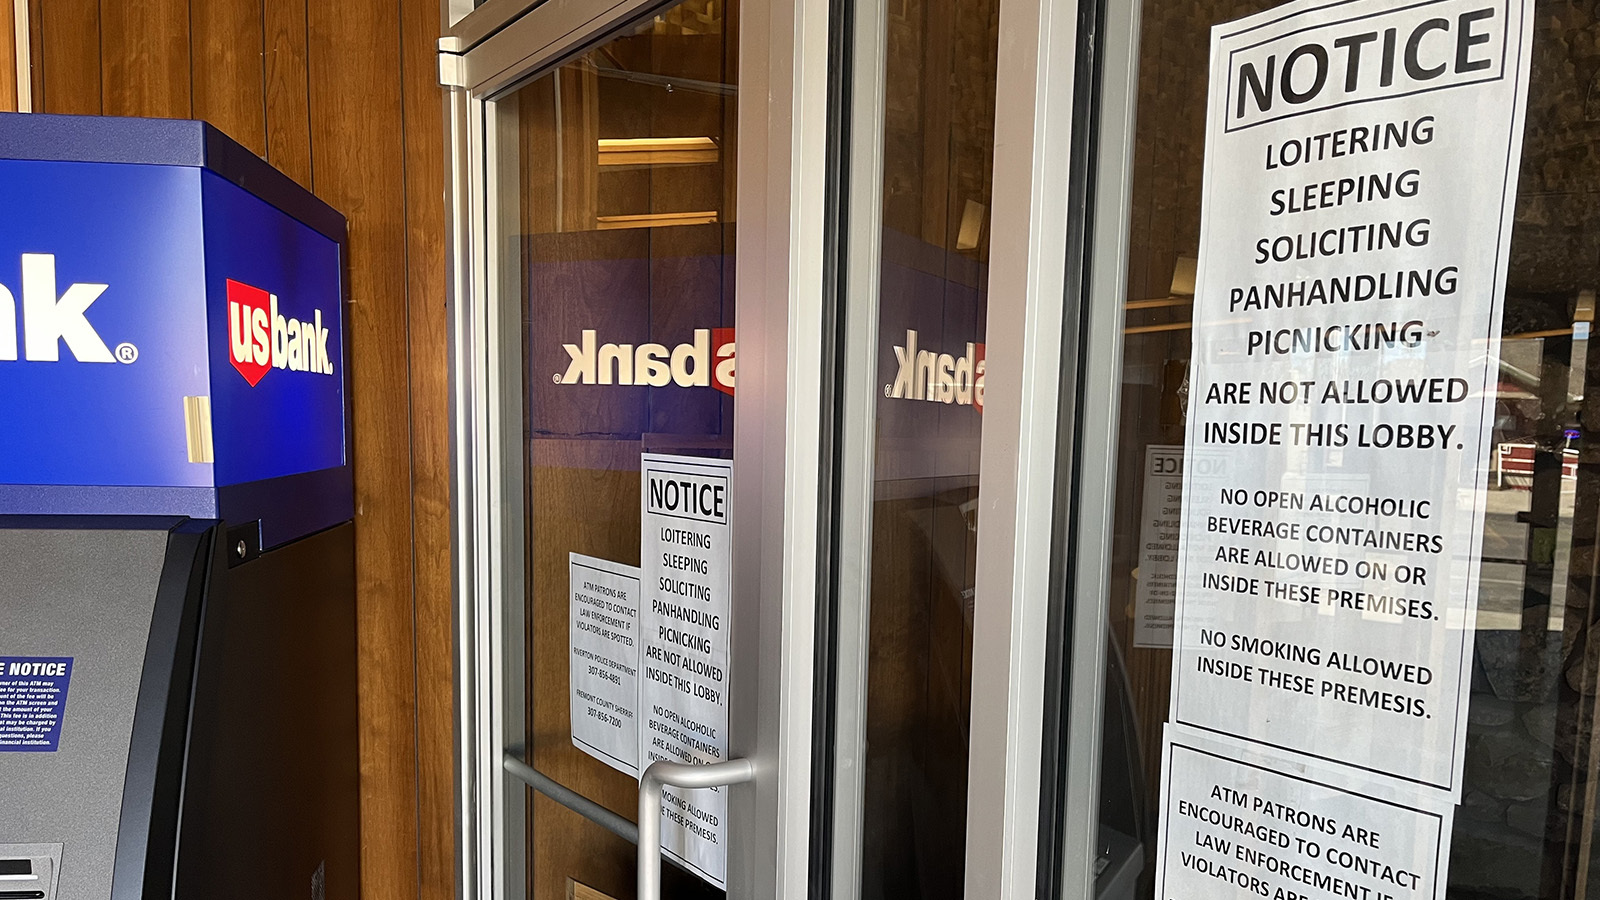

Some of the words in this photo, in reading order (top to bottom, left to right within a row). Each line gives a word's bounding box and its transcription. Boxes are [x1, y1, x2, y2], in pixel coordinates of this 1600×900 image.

[1236, 7, 1495, 119] NOTICE
[1265, 116, 1435, 170] LOITERING
[1269, 169, 1421, 216] SLEEPING
[1255, 218, 1431, 265] SOLICITING
[1229, 266, 1459, 313] PANHANDLING
[1247, 320, 1424, 356] PICNICKING
[1205, 382, 1251, 405] ARE
[1259, 381, 1316, 405] NOT
[1321, 377, 1470, 404] ALLOWED
[1203, 422, 1282, 446] INSIDE
[1289, 423, 1349, 447] THIS
[1358, 424, 1464, 450] LOBBY.
[650, 478, 724, 517] NOTICE
[1220, 488, 1248, 506] NO
[1253, 490, 1304, 510] OPEN
[1309, 494, 1431, 520] ALCOHOLIC
[660, 527, 711, 549] LOITERING
[1207, 516, 1300, 541] BEVERAGE
[1305, 524, 1444, 554] CONTAINERS
[662, 552, 708, 575] SLEEPING
[1215, 546, 1249, 565] ARE
[1254, 549, 1349, 577] ALLOWED
[1355, 560, 1387, 581] ON
[1394, 565, 1427, 586] OR
[574, 593, 606, 609] ENCOURAGED
[605, 602, 613, 611] TO
[613, 604, 637, 618] CONTACT
[583, 581, 594, 591] ATM
[594, 584, 617, 598] PATRONS
[616, 591, 627, 601] ARE
[659, 576, 711, 602] SOLICITING
[1202, 572, 1259, 596] INSIDE
[1264, 580, 1320, 605] THESE
[1327, 589, 1439, 621] PREMISES.
[576, 620, 601, 636] VIOLATORS
[601, 629, 611, 640] ARE
[610, 632, 635, 647] SPOTTED.
[579, 608, 590, 618] LAW
[591, 611, 626, 629] ENFORCEMENT
[625, 622, 631, 631] IF
[652, 599, 720, 631] PANHANDLING
[659, 625, 711, 654] PICNICKING
[1200, 629, 1226, 648] NO
[1230, 634, 1321, 666] SMOKING
[1326, 651, 1433, 686] ALLOWED
[9, 662, 67, 676] NOTICE
[574, 647, 594, 660] RIVERTON
[594, 654, 608, 666] POLICE
[608, 660, 637, 677] DEPARTMENT
[646, 645, 662, 661] ARE
[663, 650, 681, 667] NOT
[682, 657, 723, 682] ALLOWED
[576, 688, 596, 703] FREMONT
[596, 697, 614, 711] COUNTY
[645, 666, 673, 686] INSIDE
[674, 676, 691, 694] THIS
[693, 683, 723, 706] LOBBY.
[1197, 656, 1253, 682] INSIDE
[1258, 668, 1314, 695] THESE
[1320, 680, 1431, 719] PREMESIS.
[648, 719, 679, 740] BEVERAGE
[680, 733, 720, 758] CONTAINERS
[653, 704, 663, 716] NO
[664, 709, 679, 723] OPEN
[680, 717, 716, 739] ALCOHOLIC
[652, 737, 665, 749] ARE
[665, 742, 692, 763] ALLOWED
[662, 790, 687, 811] MOKING
[687, 803, 719, 827] ALLOWED
[666, 808, 684, 826] THESE
[685, 818, 719, 845] PREMESIS.
[1210, 784, 1248, 809] ATM
[1253, 796, 1337, 836] PATRONS
[1341, 823, 1380, 849] ARE
[1178, 799, 1290, 850] ENCOURAGED
[1295, 836, 1320, 859] TO
[1325, 847, 1421, 891] CONTACT
[1180, 851, 1270, 898] VIOLATORS
[1195, 830, 1231, 856] LAW
[1235, 844, 1371, 900] ENFORCEMENT
